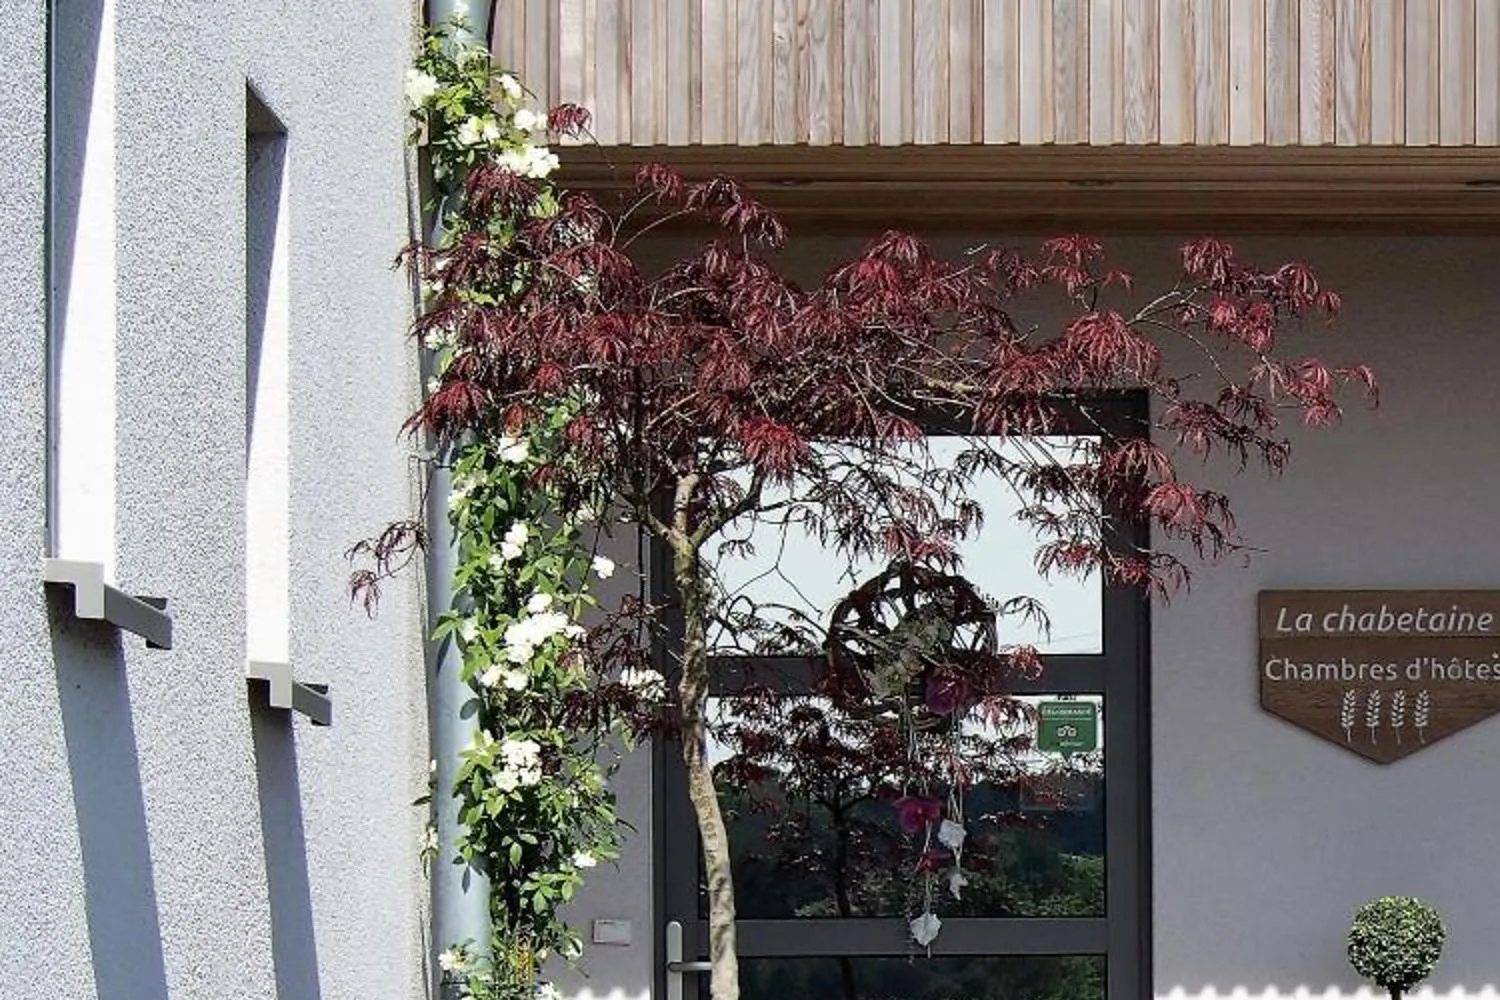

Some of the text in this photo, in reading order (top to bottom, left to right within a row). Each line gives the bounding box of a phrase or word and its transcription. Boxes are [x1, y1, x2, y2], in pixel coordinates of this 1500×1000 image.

[1276, 604, 1494, 633] La chabetaine
[1265, 657, 1398, 681] Chambres
